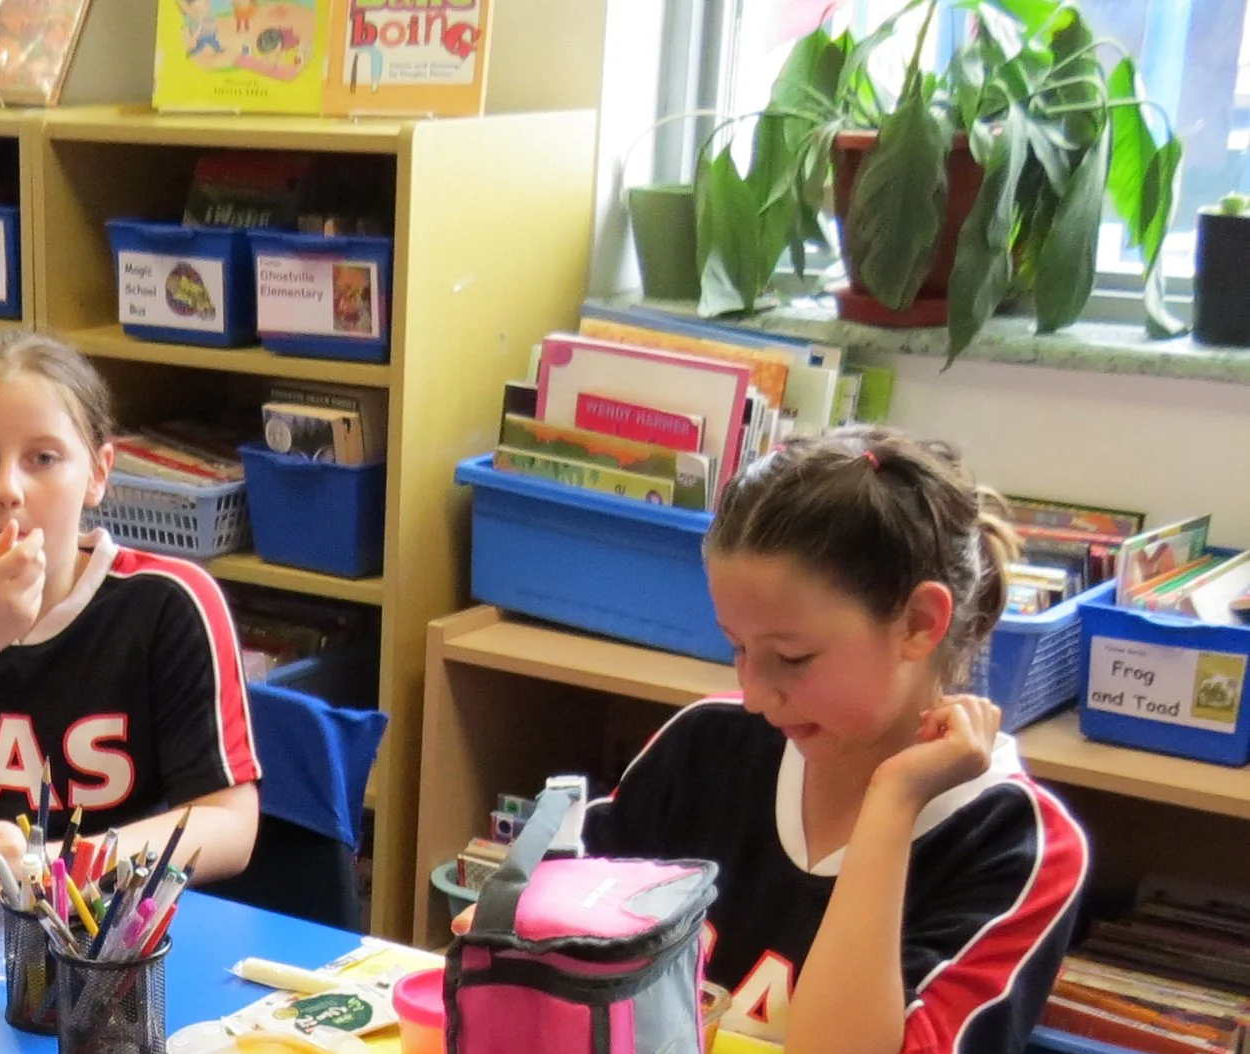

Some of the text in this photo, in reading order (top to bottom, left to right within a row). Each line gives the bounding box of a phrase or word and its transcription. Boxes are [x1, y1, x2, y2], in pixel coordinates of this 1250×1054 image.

[125, 263, 152, 279] Magic
[125, 283, 157, 298] School
[260, 284, 324, 302] Elementary
[129, 304, 146, 318] Bus
[1111, 660, 1156, 686] Frog
[1091, 691, 1181, 717] and Toad
